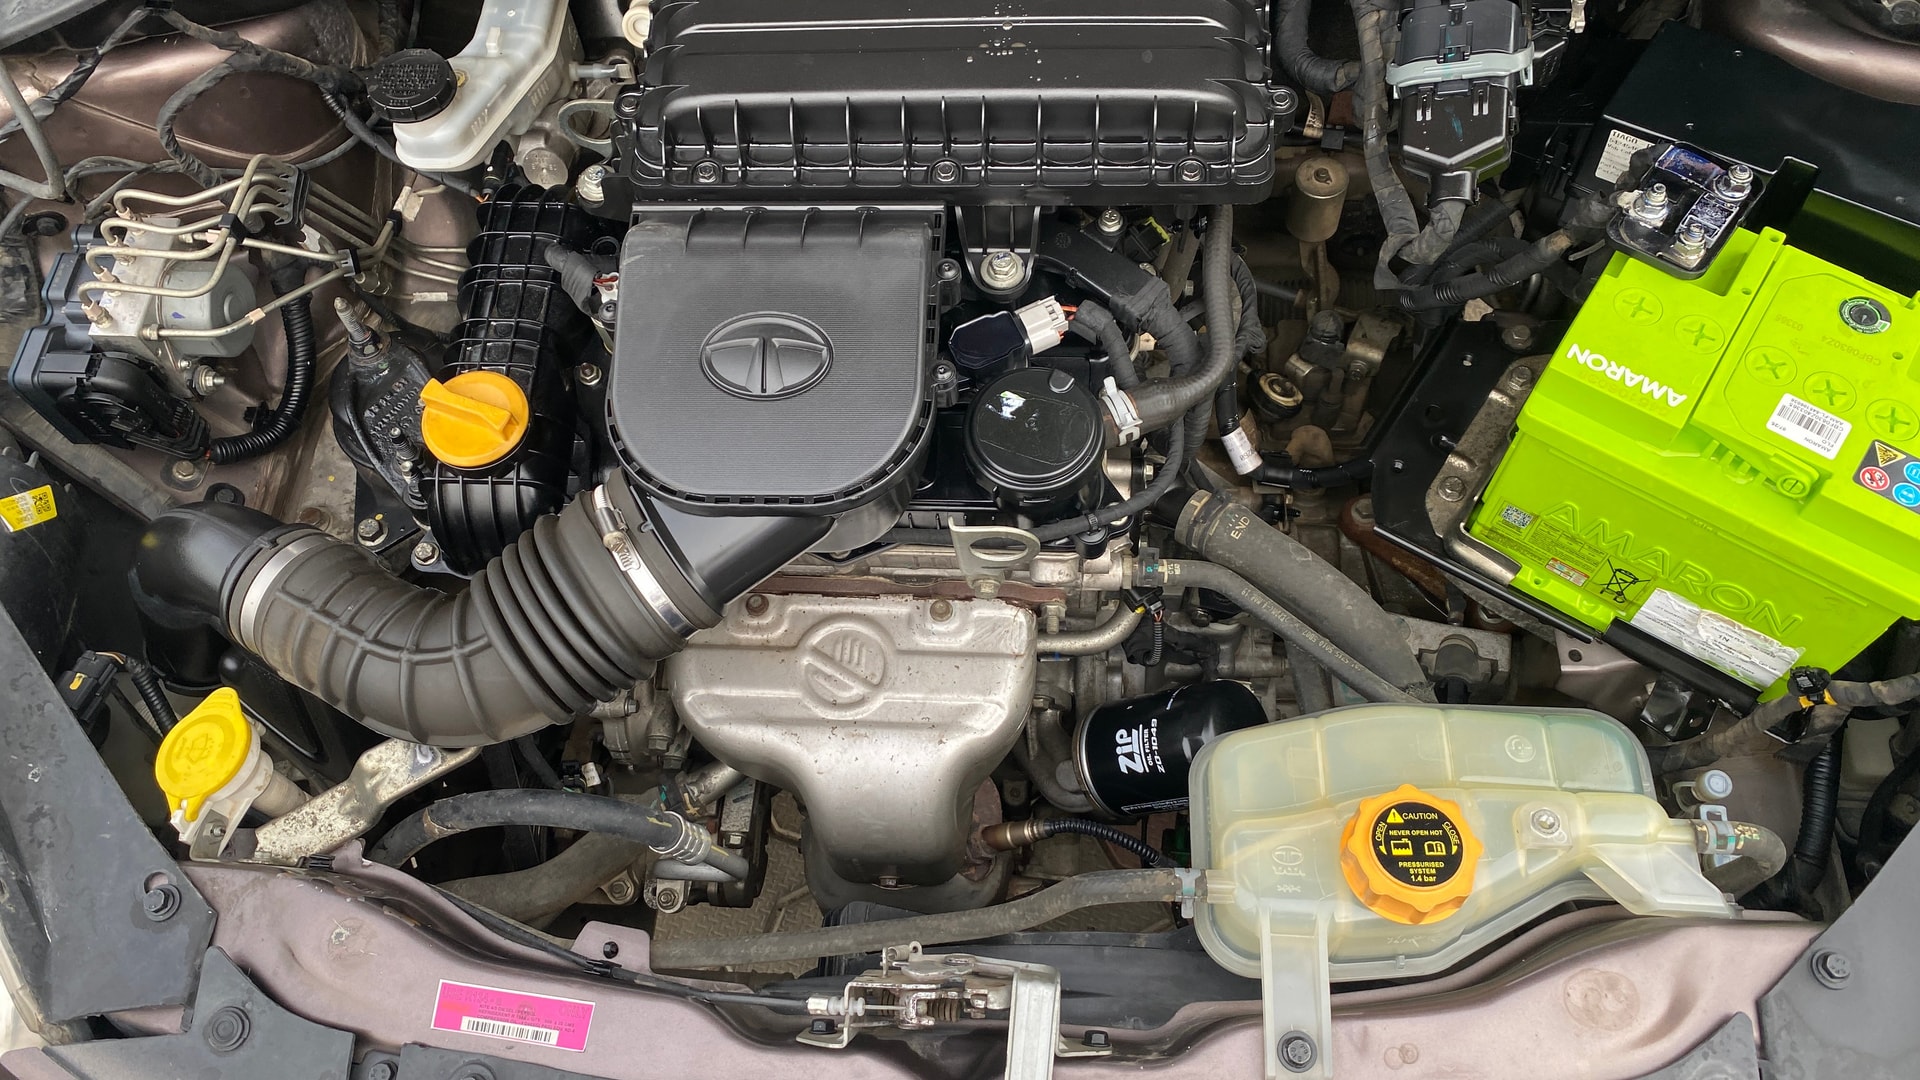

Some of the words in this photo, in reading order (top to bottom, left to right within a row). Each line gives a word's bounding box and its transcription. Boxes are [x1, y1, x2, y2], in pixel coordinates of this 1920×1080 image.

[1567, 343, 1688, 407] AMARON
[1803, 436, 1832, 454] AMARON
[1230, 515, 1250, 540] END
[1543, 501, 1803, 636] AMARON
[1146, 754, 1154, 766] OIL
[1402, 812, 1438, 820] CAUTION
[1375, 821, 1386, 841] OPEN
[1443, 821, 1460, 845] CLOSE
